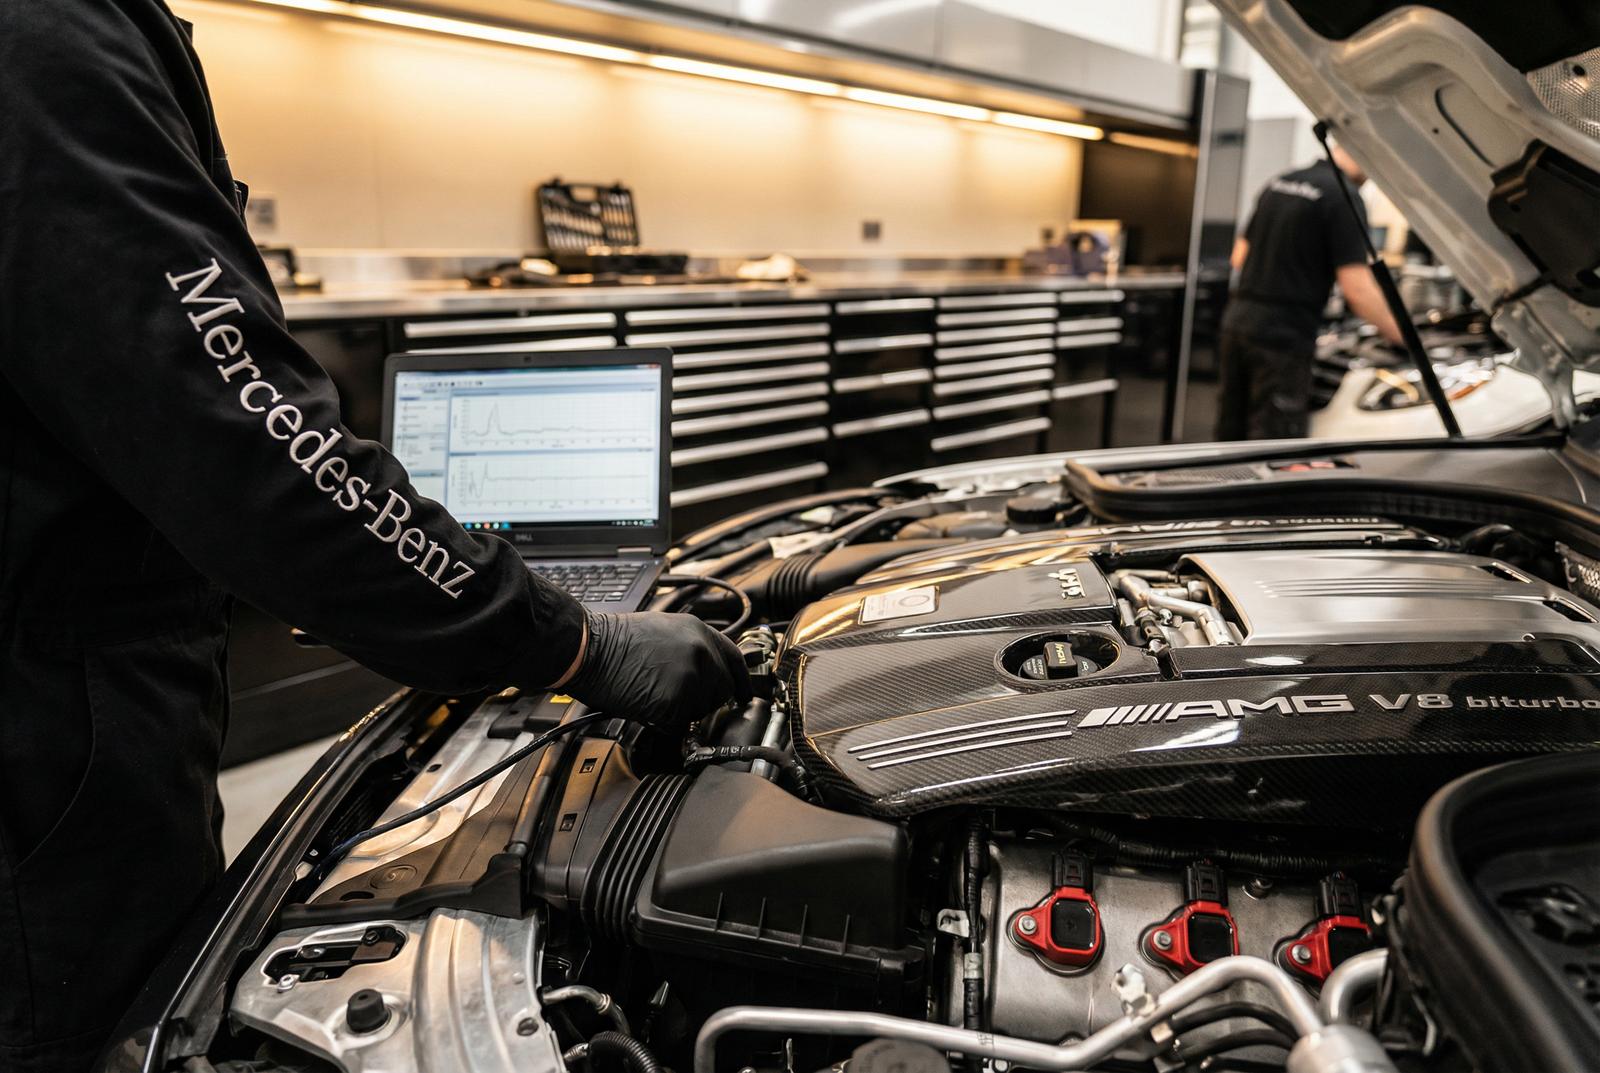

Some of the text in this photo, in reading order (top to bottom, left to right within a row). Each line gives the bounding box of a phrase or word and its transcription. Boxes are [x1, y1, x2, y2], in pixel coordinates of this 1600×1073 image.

[165, 257, 476, 599] Mercedes-Benz
[1165, 693, 1600, 722] AMG V8 biturbo
